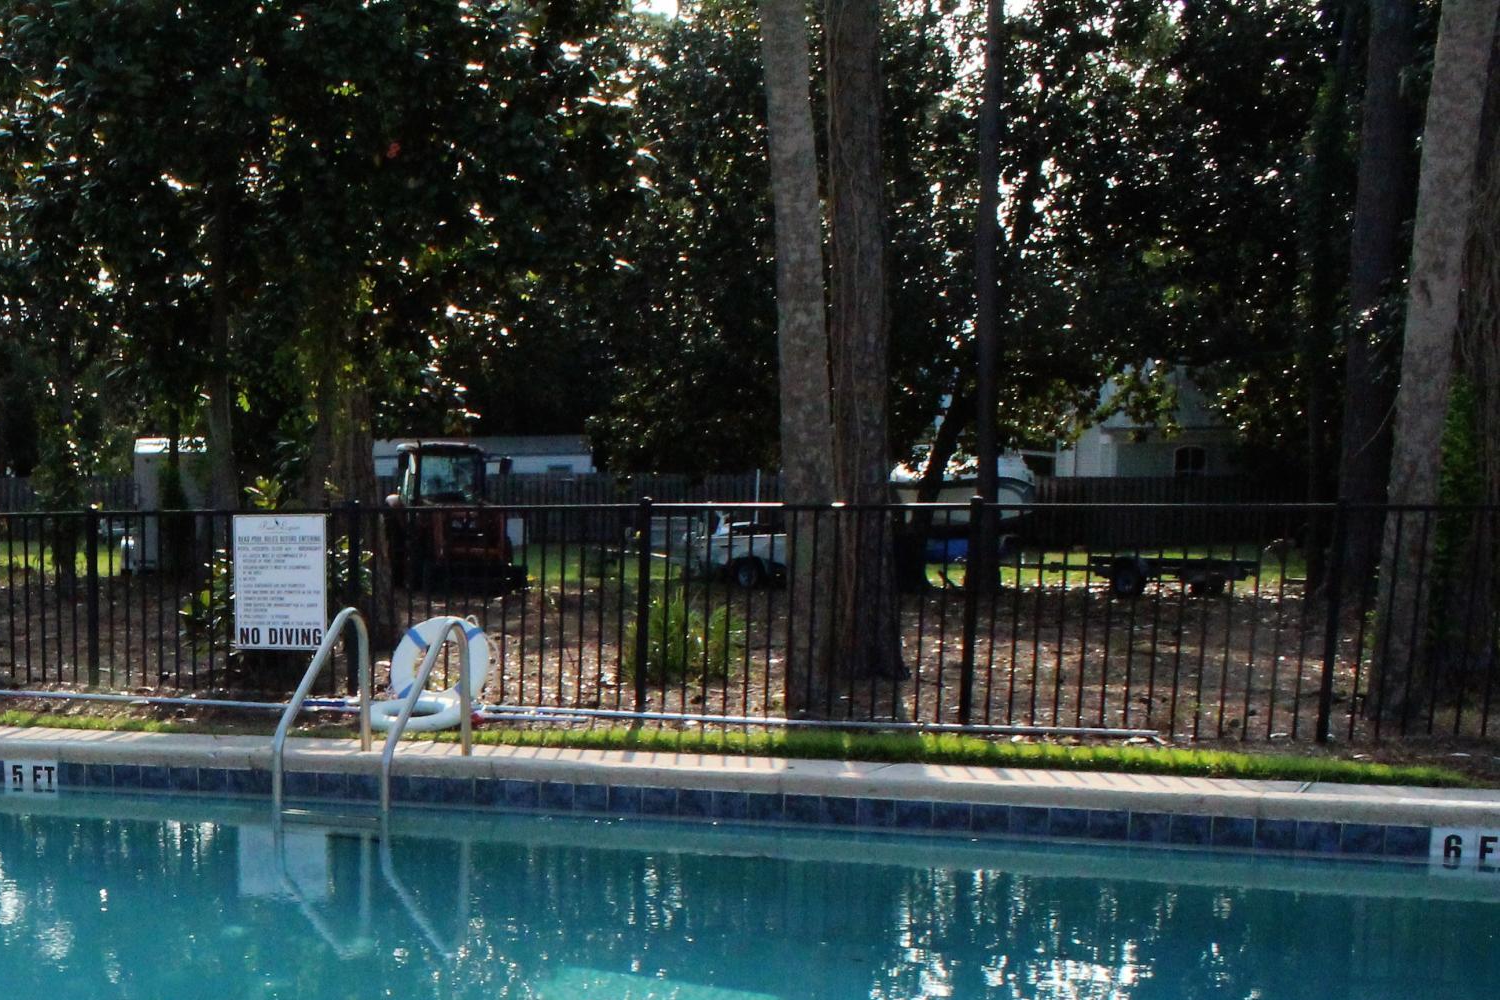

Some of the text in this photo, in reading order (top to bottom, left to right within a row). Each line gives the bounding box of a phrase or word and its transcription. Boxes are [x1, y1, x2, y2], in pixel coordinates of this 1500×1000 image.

[240, 627, 322, 646] NO DIVING
[12, 764, 55, 789] 5 FT
[1443, 834, 1500, 865] 6 F
